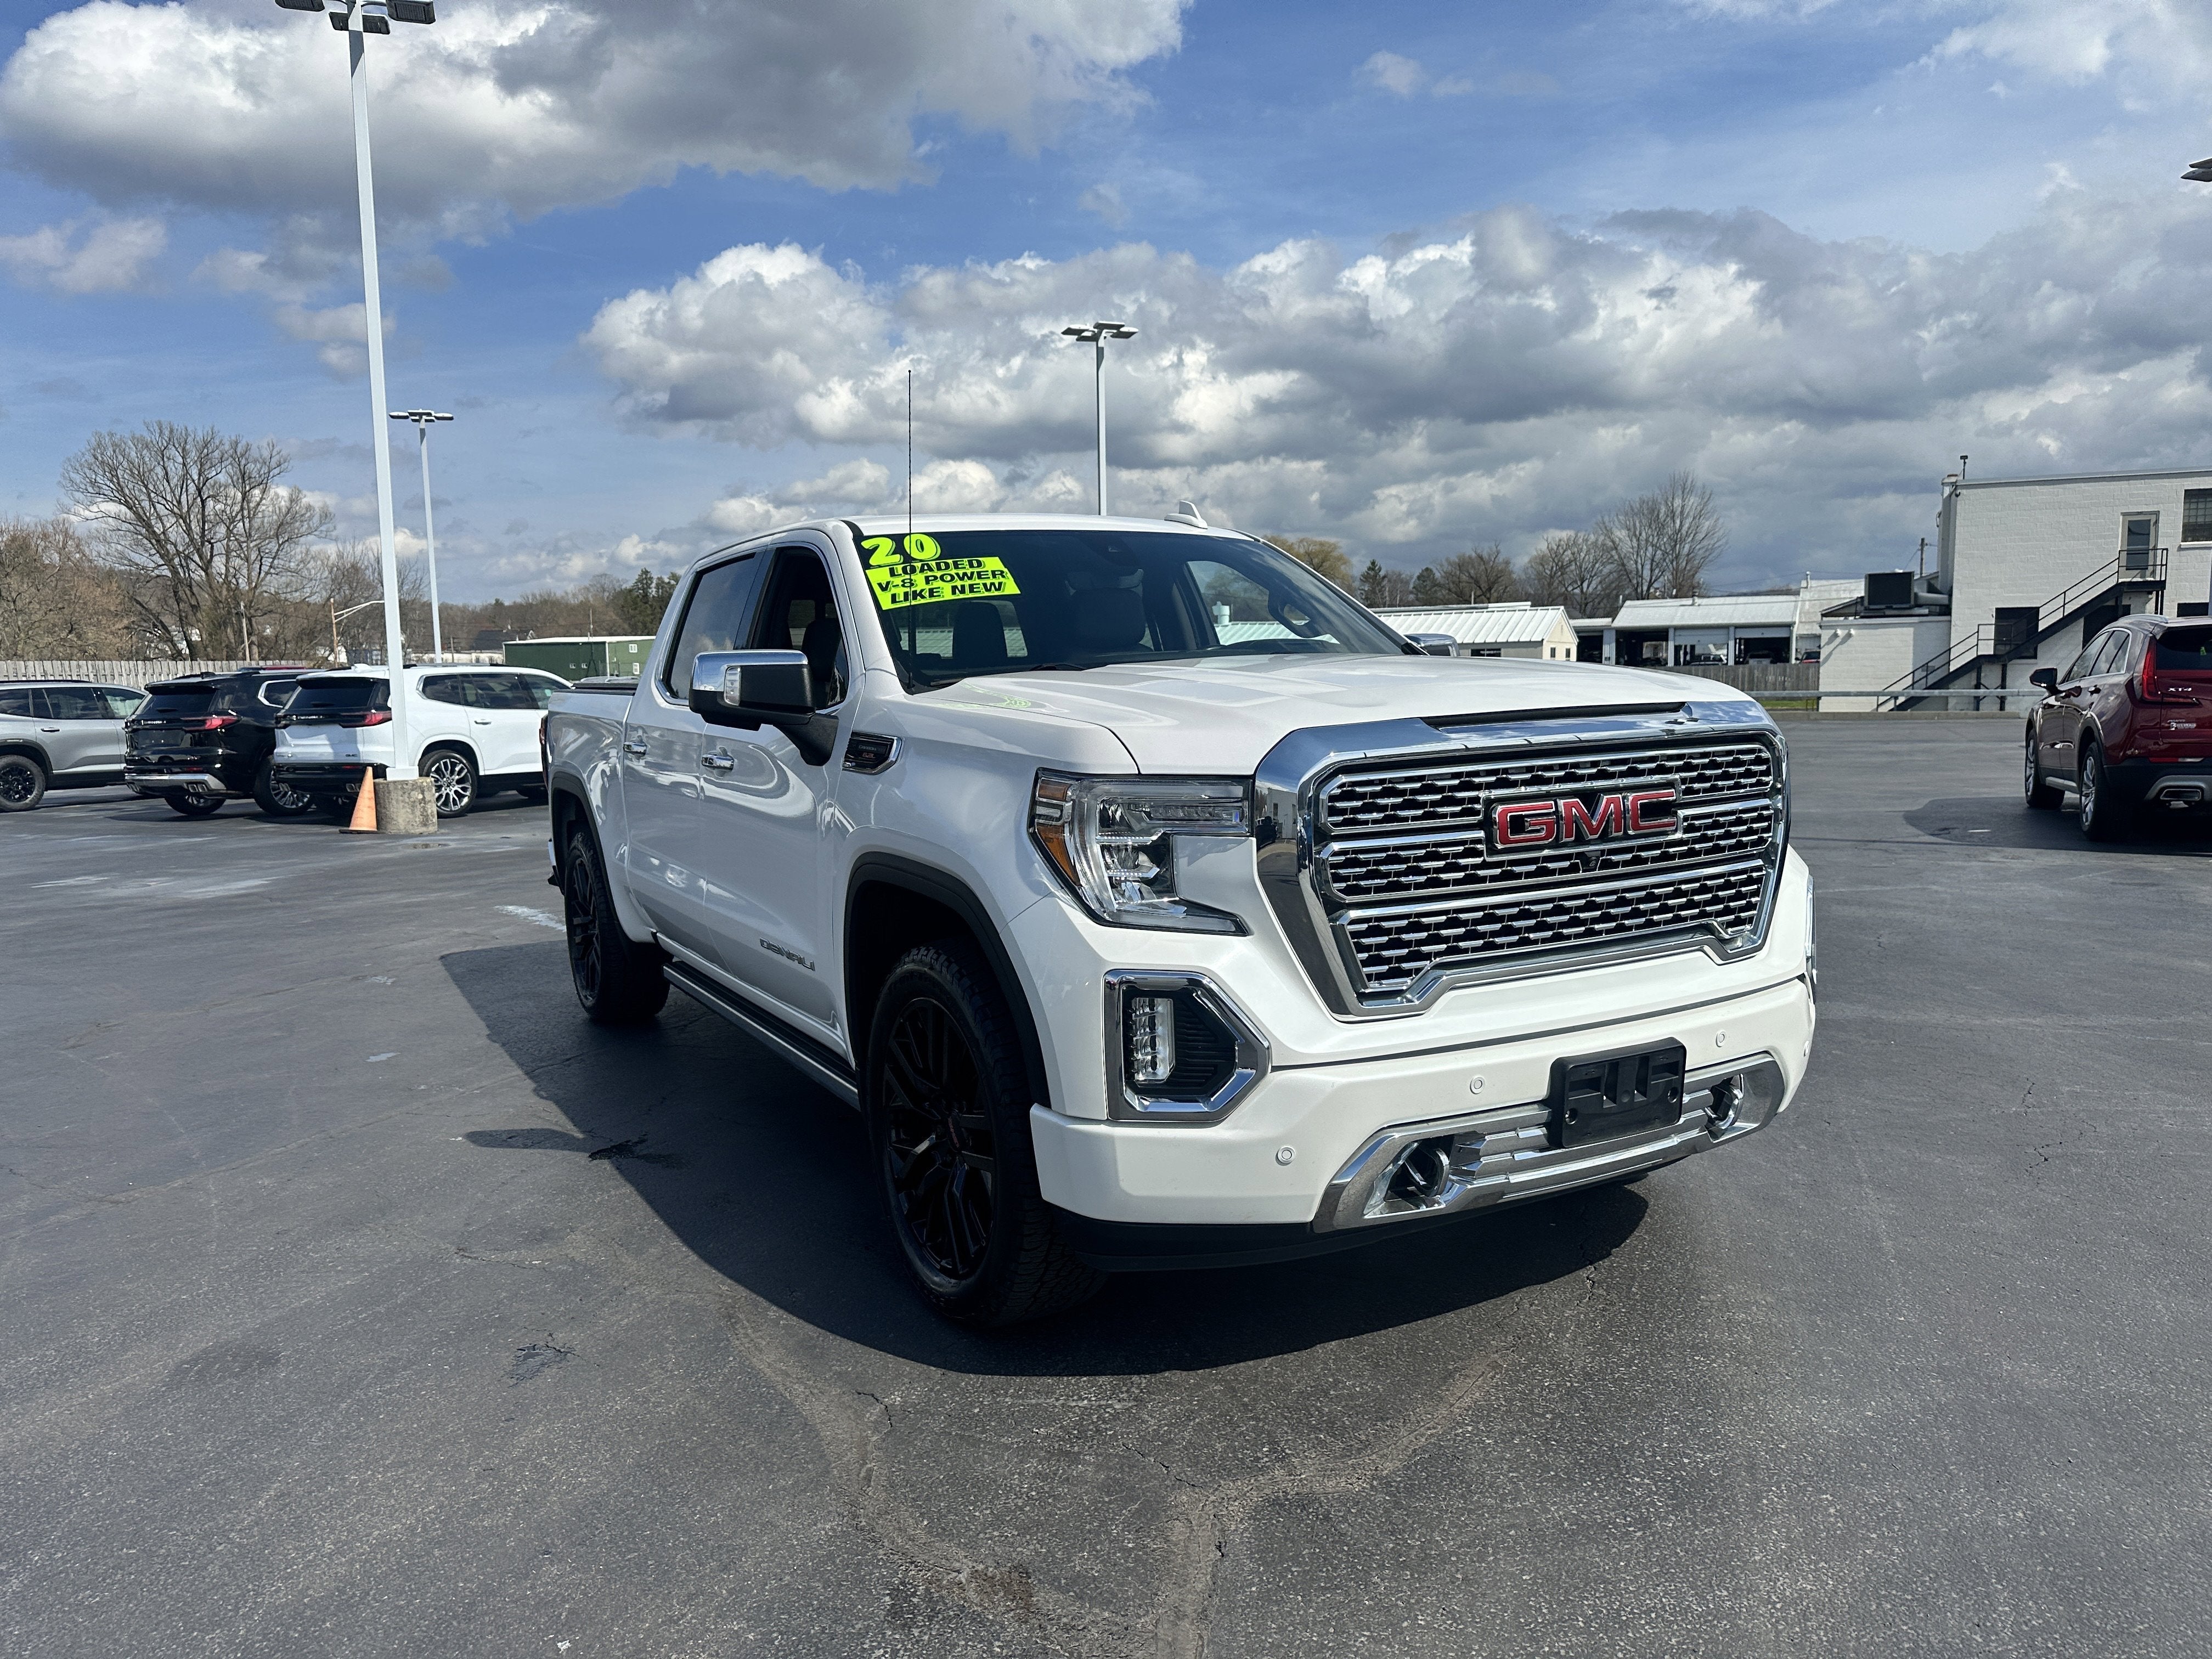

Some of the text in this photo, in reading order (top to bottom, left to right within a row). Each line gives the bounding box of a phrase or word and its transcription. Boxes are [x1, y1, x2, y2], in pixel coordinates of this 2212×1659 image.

[861, 533, 941, 566] 20
[877, 569, 1008, 592] V-8 POWER
[889, 558, 985, 578] LOADED
[890, 582, 1005, 605] LIKE NEW
[1494, 789, 1677, 848] GMC
[760, 937, 815, 971] DENALI
